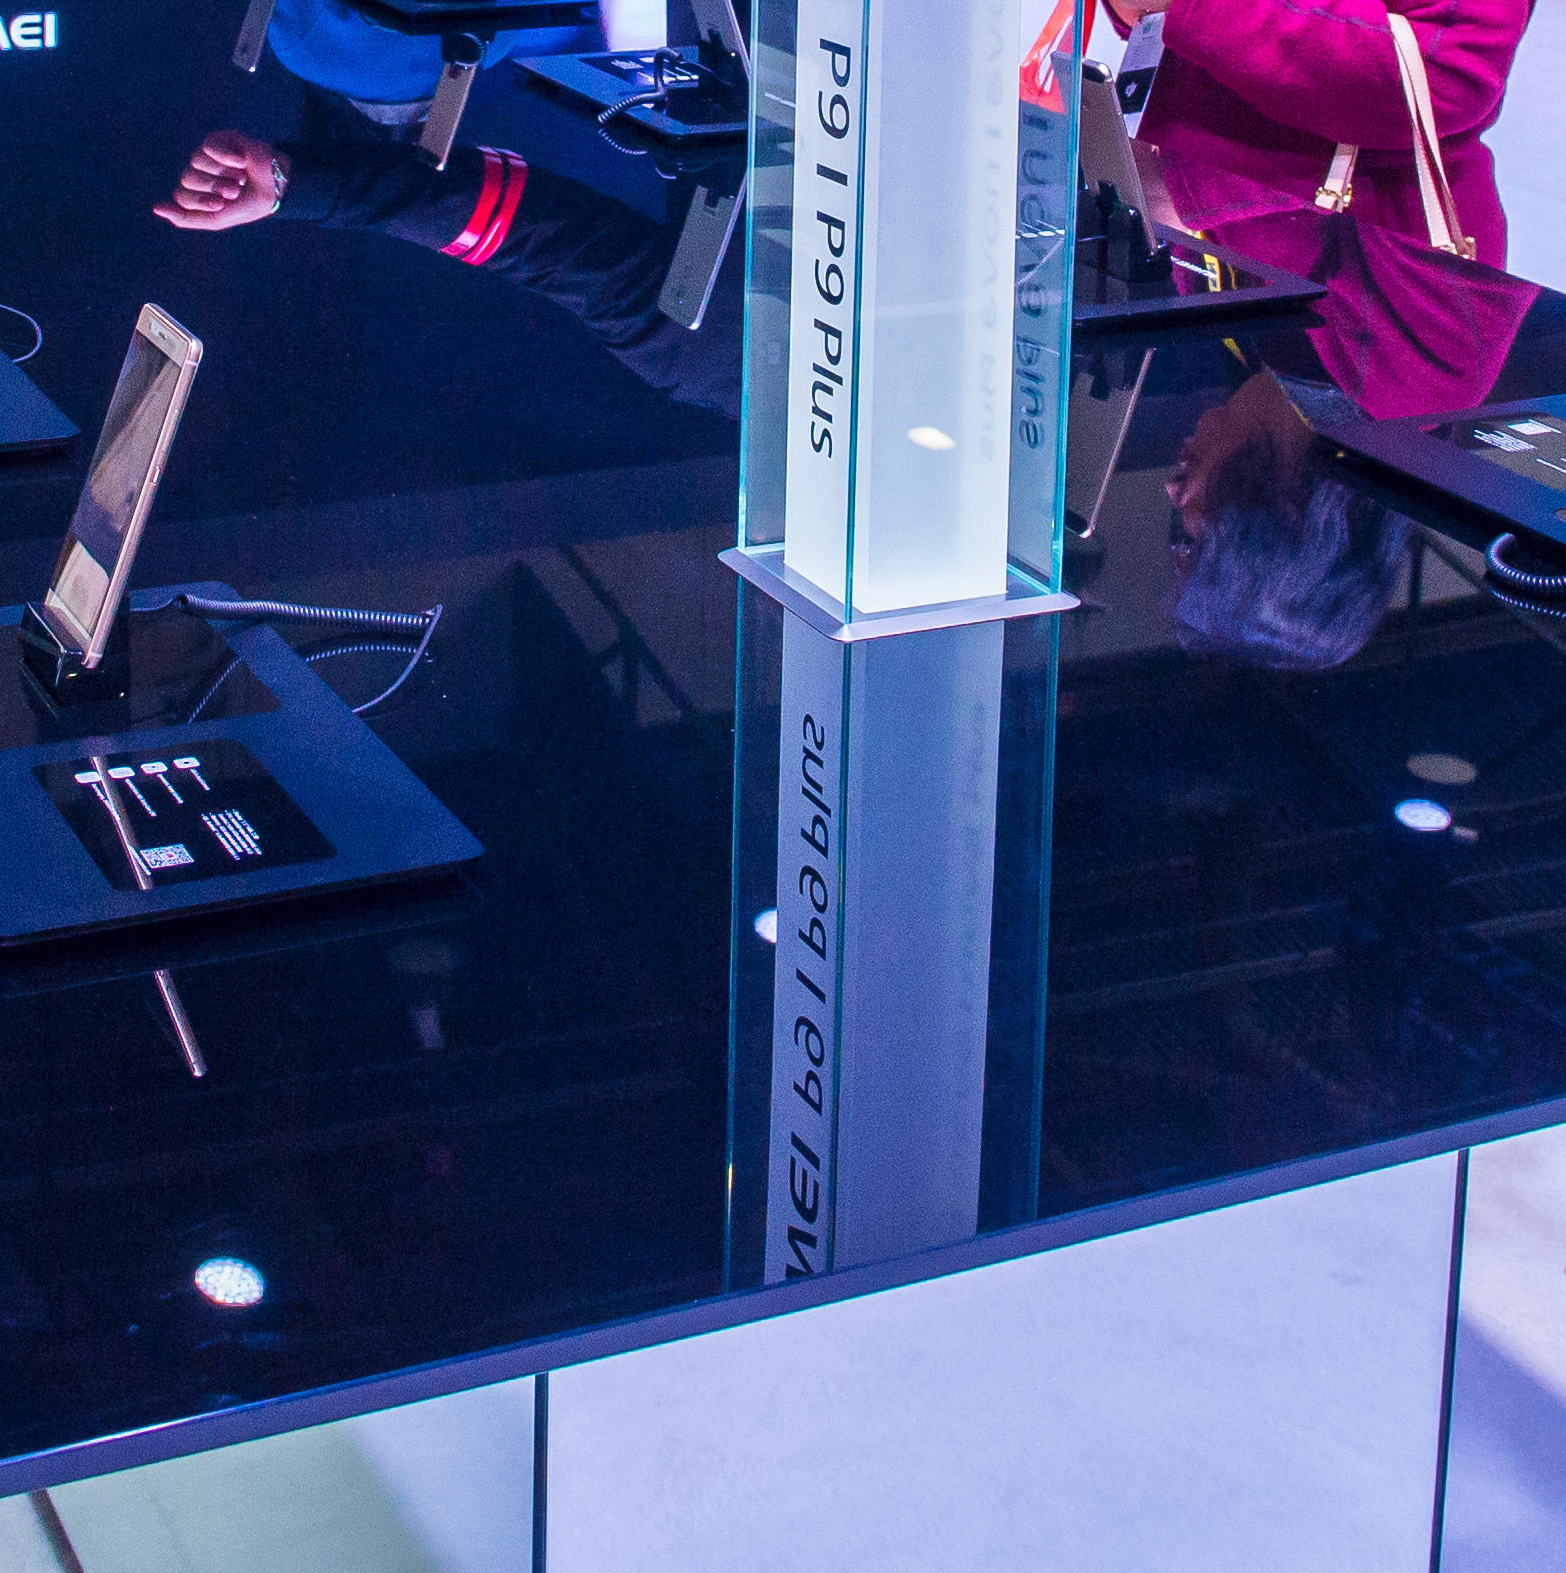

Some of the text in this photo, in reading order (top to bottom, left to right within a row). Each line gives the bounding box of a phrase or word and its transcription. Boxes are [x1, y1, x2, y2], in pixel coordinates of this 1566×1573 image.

[817, 37, 852, 140] P9
[814, 210, 846, 306] P9
[810, 317, 844, 460] Plus
